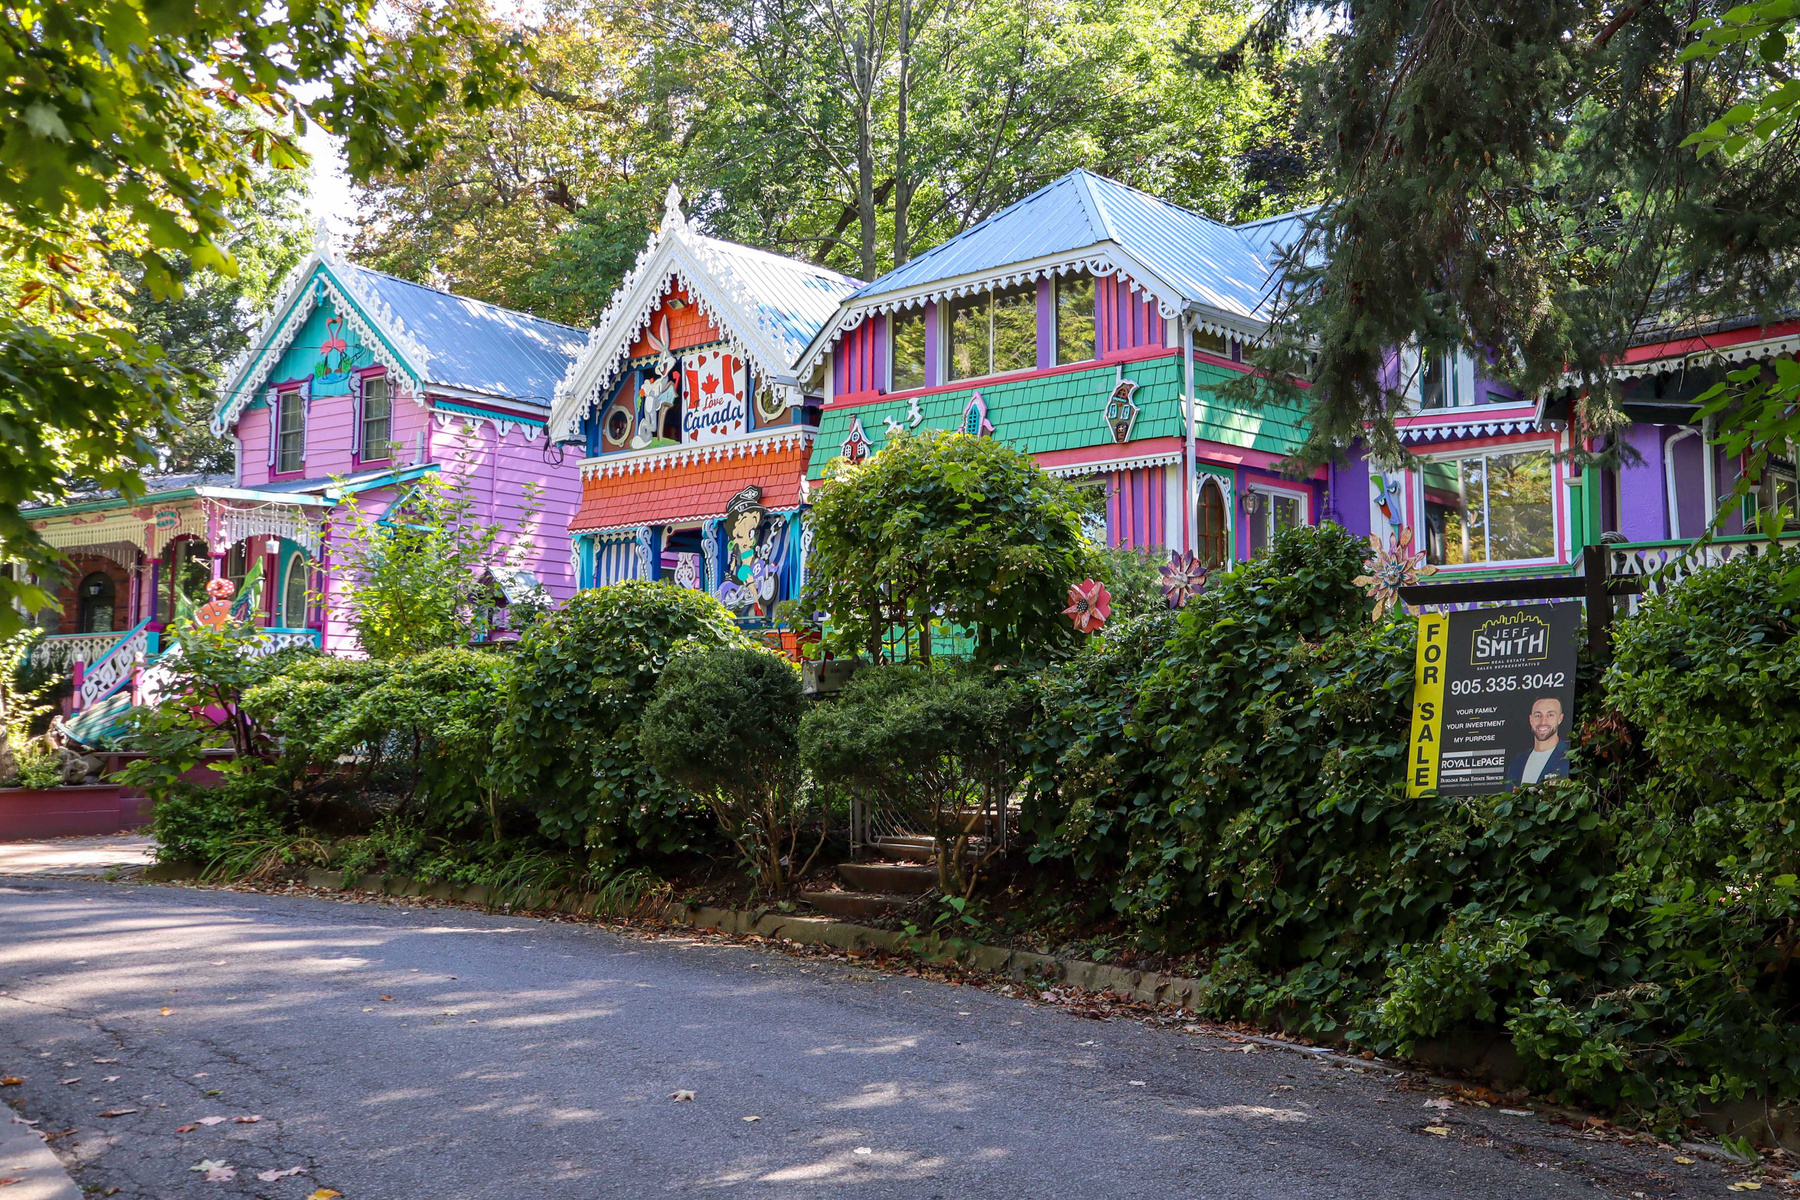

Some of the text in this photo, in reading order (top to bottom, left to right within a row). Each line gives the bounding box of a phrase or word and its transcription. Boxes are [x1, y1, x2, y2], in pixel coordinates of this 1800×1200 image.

[702, 396, 724, 411] Love
[683, 400, 744, 432] Canada
[1492, 627, 1530, 639] JEFF
[1476, 628, 1545, 658] SMITH
[1450, 672, 1565, 696] 905.335.3042
[1415, 623, 1442, 787] FOR SALE
[1456, 706, 1498, 716] YOUR FAMILY
[1465, 720, 1505, 729] INVESTMENT
[1441, 759, 1470, 769] ROYAL
